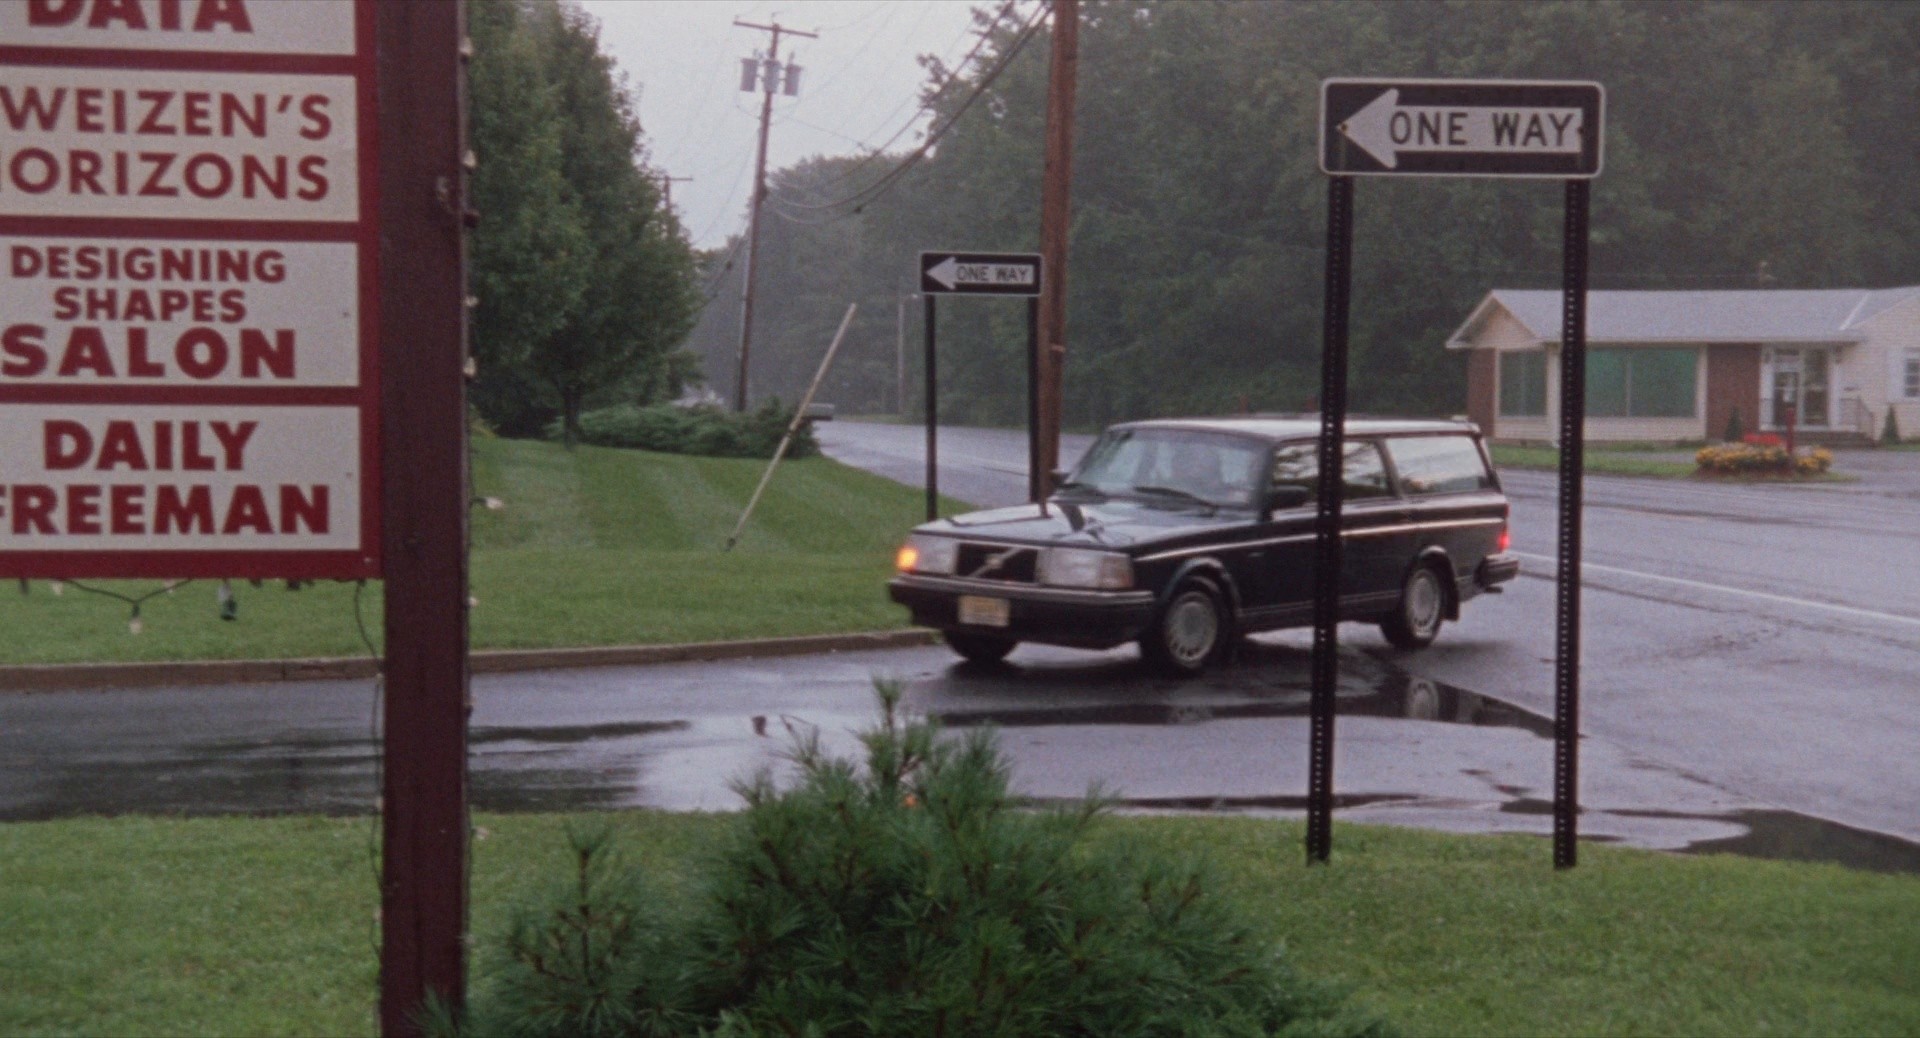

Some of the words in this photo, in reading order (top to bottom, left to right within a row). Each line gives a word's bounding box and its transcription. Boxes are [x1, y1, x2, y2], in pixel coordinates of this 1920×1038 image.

[0, 86, 332, 141] WEIZEN'S
[1389, 111, 1468, 145] ONE
[1491, 112, 1573, 147] WAY
[0, 147, 329, 201] ORIZONS
[10, 245, 286, 283] DESIGNING
[956, 265, 990, 281] ONE
[995, 266, 1030, 281] WAY
[53, 286, 247, 323] SHAPES
[1, 323, 296, 379] SALON
[43, 420, 259, 471] DAILY
[0, 484, 330, 535] REEMAN
